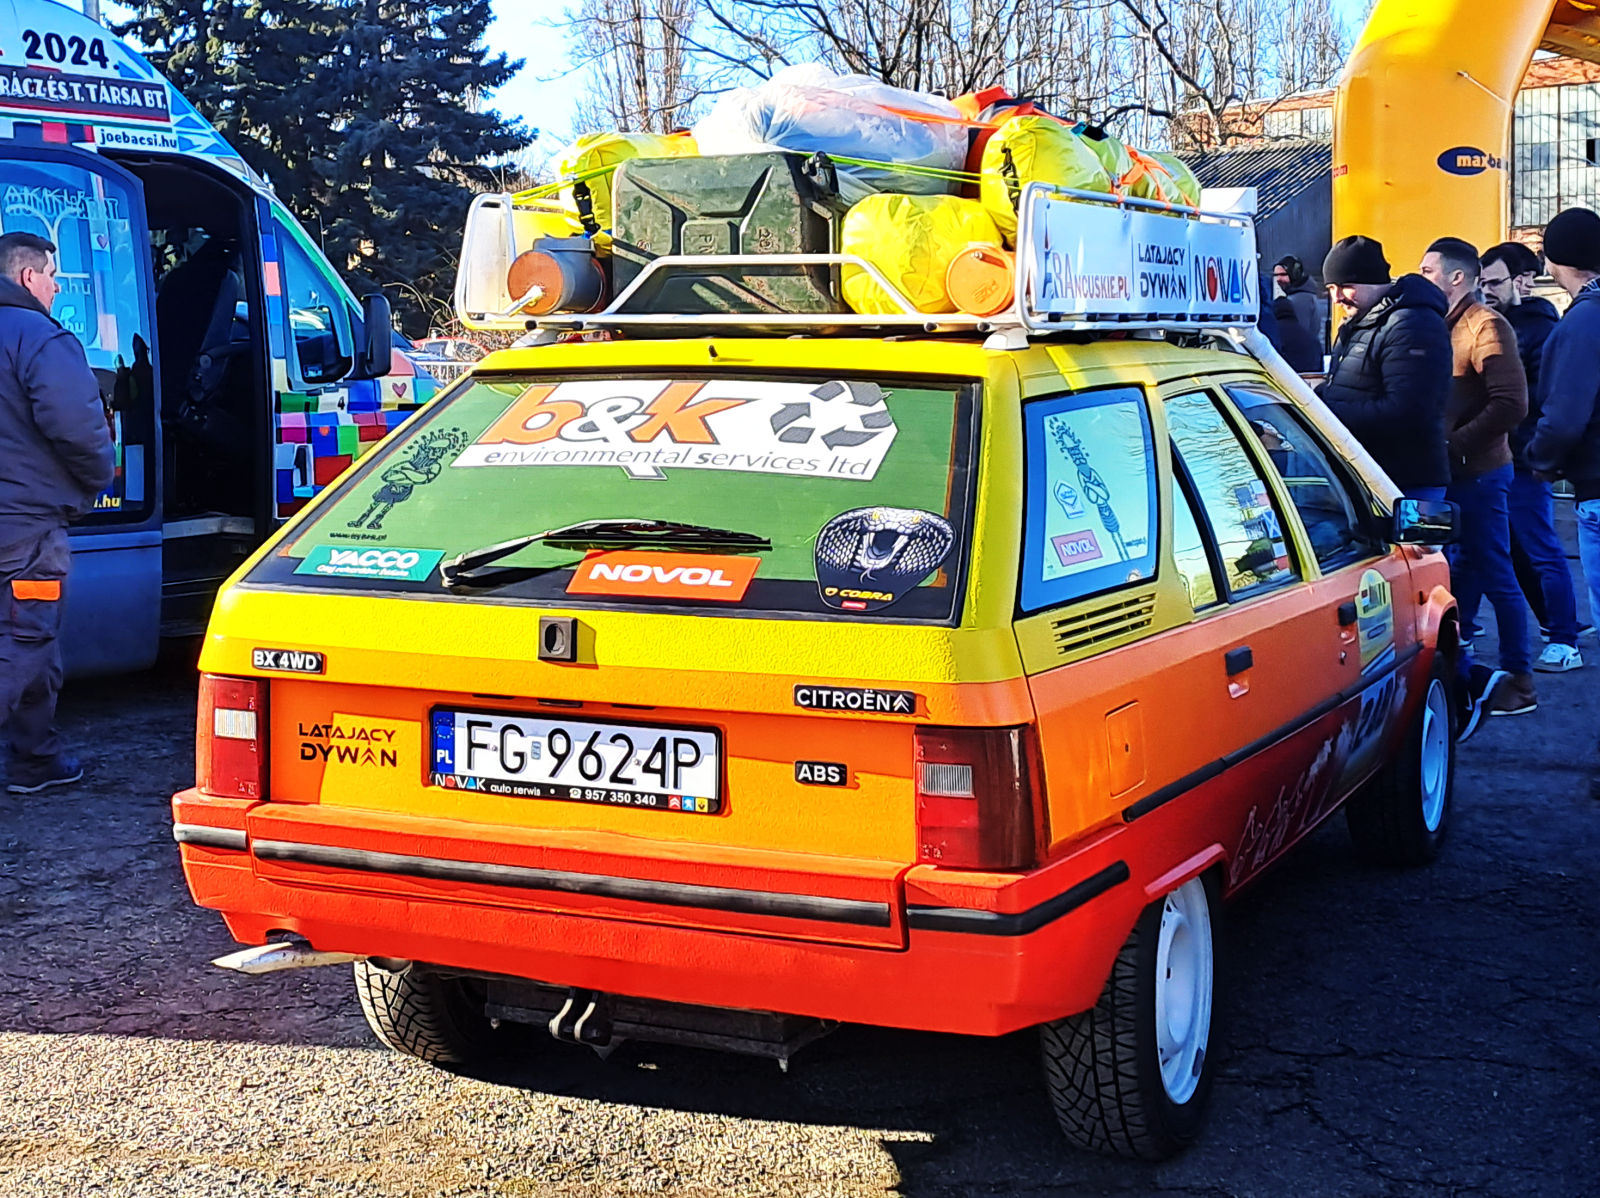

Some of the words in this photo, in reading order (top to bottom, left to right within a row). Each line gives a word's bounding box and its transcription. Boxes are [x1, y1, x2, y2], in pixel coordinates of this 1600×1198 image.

[22, 29, 120, 70] 2024.
[86, 80, 143, 107] TÁRSA
[143, 89, 167, 110] BT.
[99, 129, 177, 148] joebacsi.hu
[476, 381, 763, 445] b&k
[484, 446, 692, 464] environmental
[694, 451, 821, 472] services
[828, 456, 872, 476] ltd
[330, 549, 419, 569] YACCO
[1060, 539, 1096, 557] NOVOL
[589, 564, 733, 588] NOVOL
[839, 589, 893, 602] COBRA
[253, 650, 275, 668] BX
[279, 652, 317, 670] 4WD
[796, 688, 891, 712] CITROËN
[436, 749, 453, 764] PL
[466, 720, 526, 774] FG
[547, 727, 702, 790] 9624P
[798, 764, 841, 783] ABS
[490, 783, 512, 794] auto
[514, 786, 541, 796] serwis
[585, 789, 607, 801] 957
[610, 791, 631, 803] 350
[634, 794, 657, 806] 340
